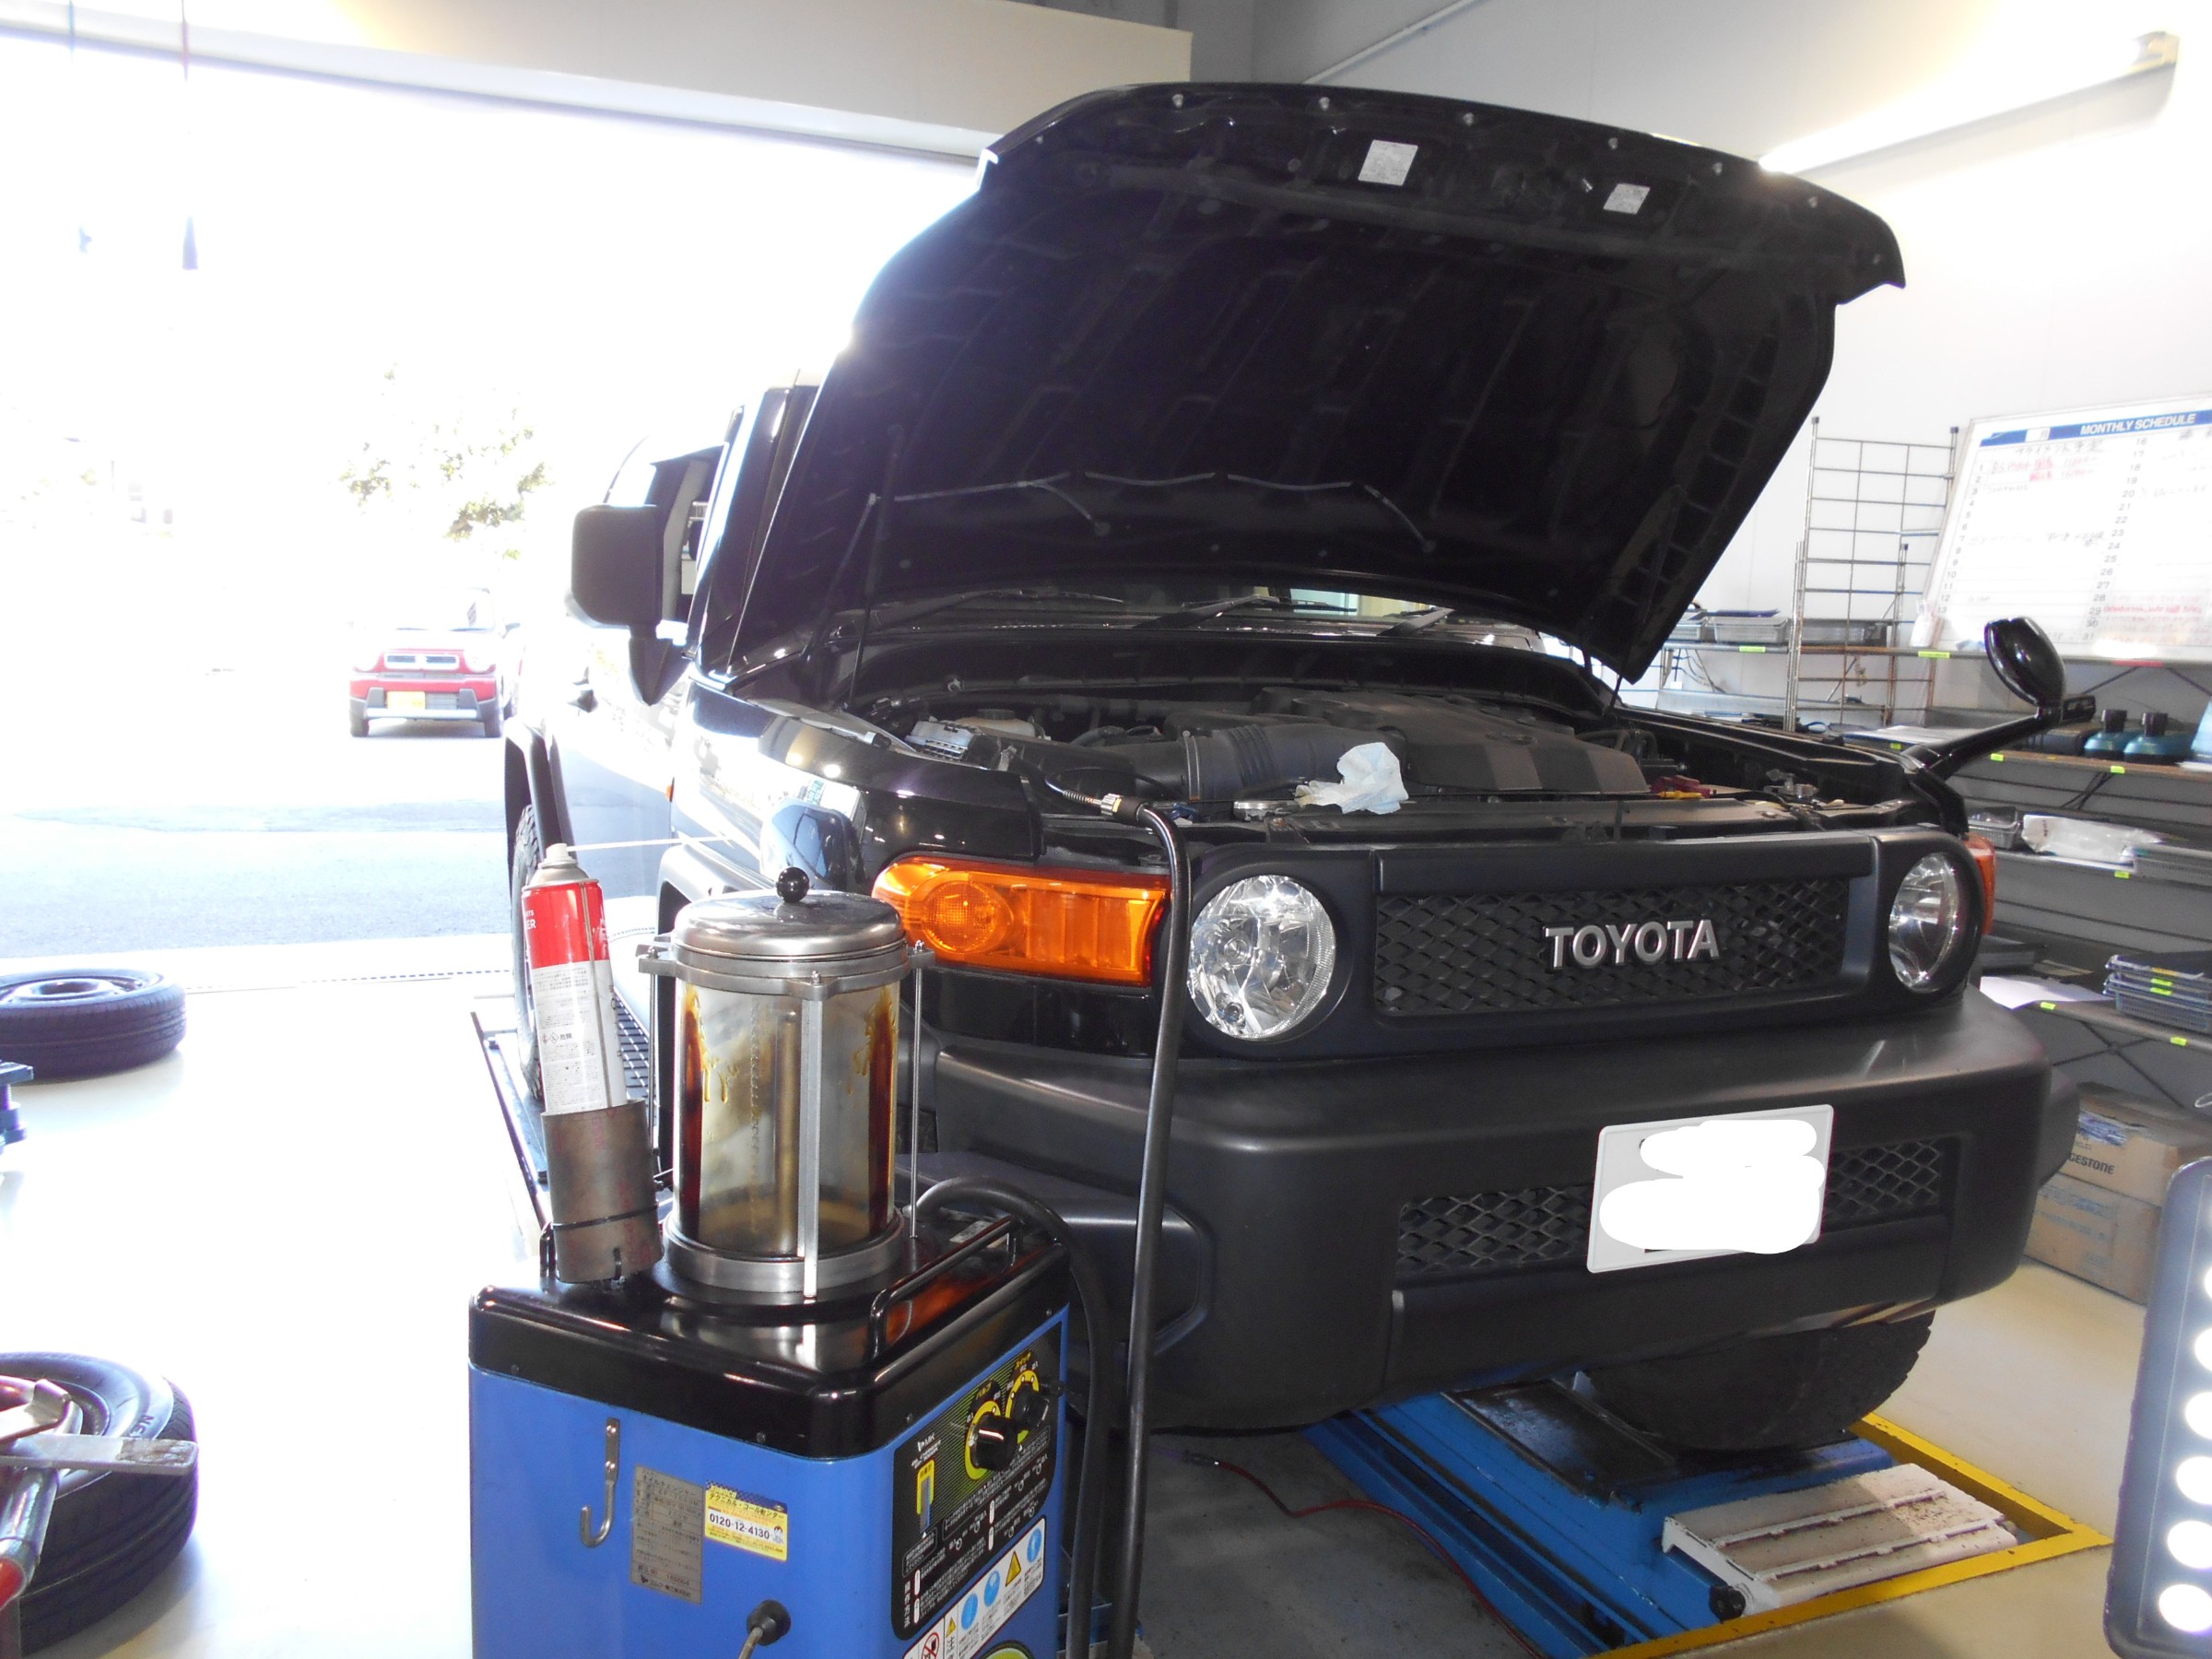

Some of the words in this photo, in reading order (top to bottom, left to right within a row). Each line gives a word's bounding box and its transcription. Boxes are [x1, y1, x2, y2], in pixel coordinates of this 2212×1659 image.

[2080, 419, 2134, 435] MONTHLY
[2135, 413, 2197, 429] SCHEDULE
[2133, 450, 2145, 458] 17
[2129, 464, 2141, 472] 18
[2126, 477, 2138, 485] 19
[2122, 489, 2136, 498] 20
[2100, 568, 2113, 576] 26
[2093, 594, 2106, 602] 28
[1545, 919, 1720, 971] TOYOTA
[2069, 1153, 2115, 1175] GESTONE
[709, 1512, 771, 1540] 0120-12-4130
